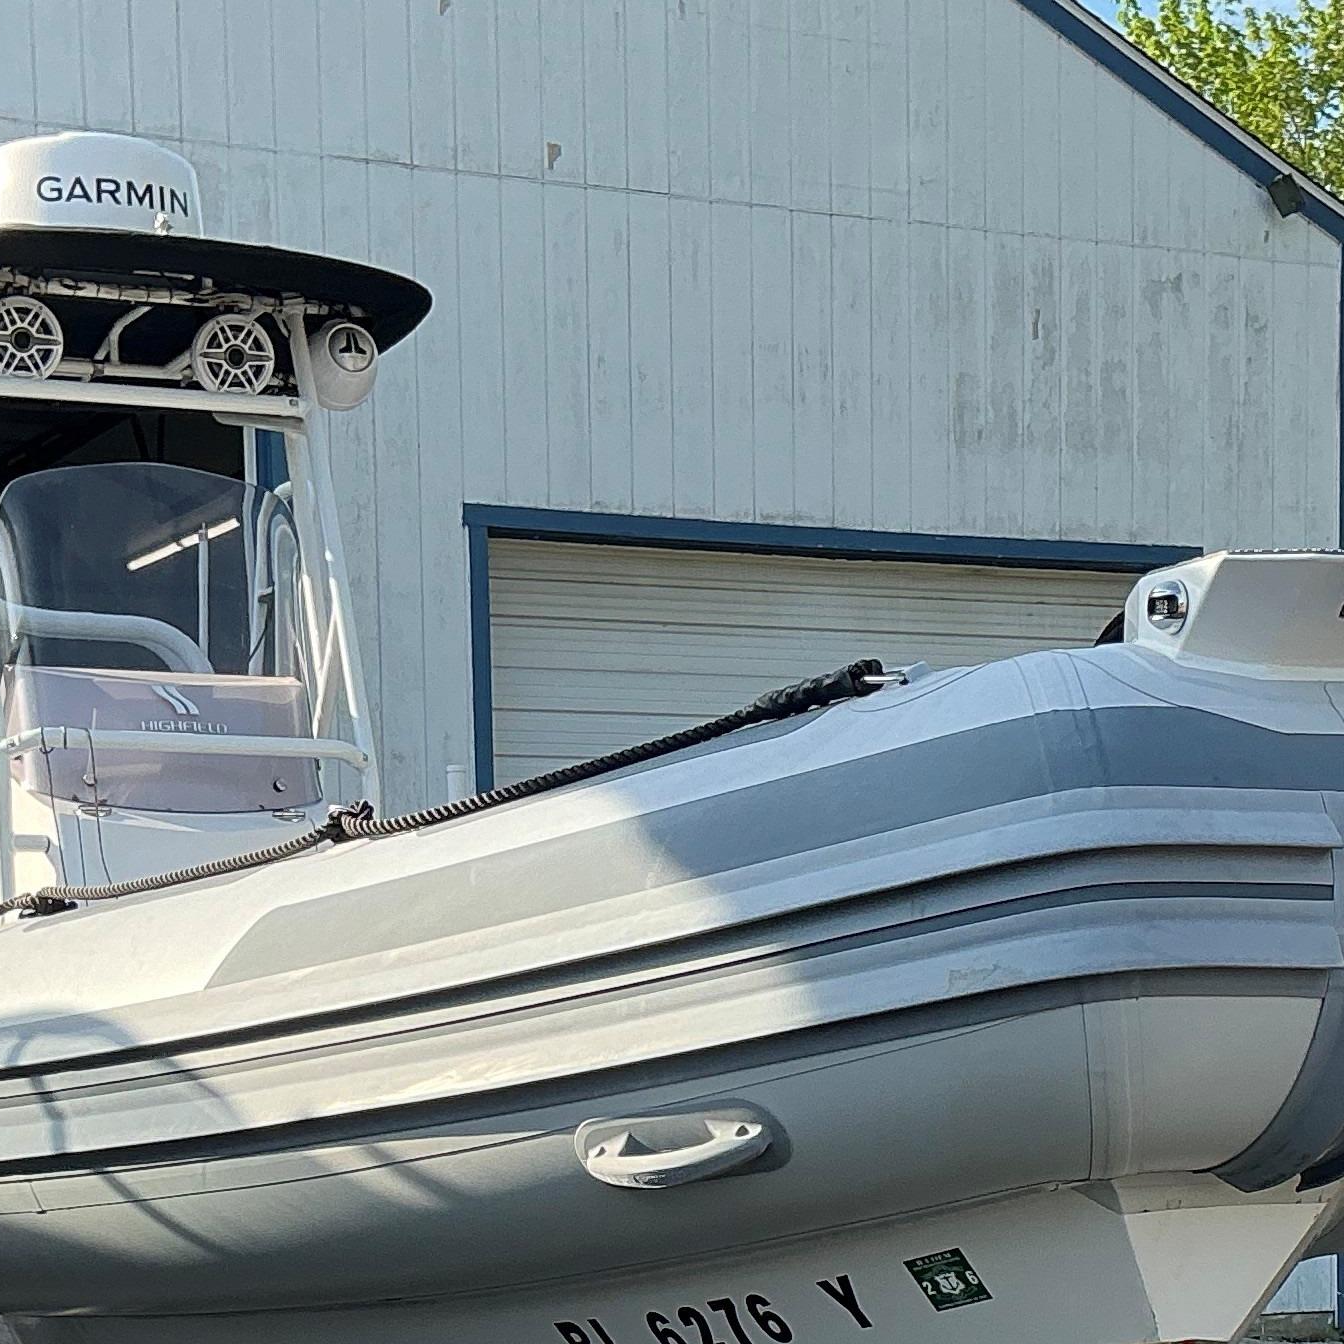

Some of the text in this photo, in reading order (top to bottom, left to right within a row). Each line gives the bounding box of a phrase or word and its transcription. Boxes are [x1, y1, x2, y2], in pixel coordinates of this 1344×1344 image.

[36, 175, 189, 218] GARMIN
[140, 720, 228, 734] HIGHFIELD
[921, 1269, 980, 1296] 2 6
[815, 1274, 873, 1330] Y
